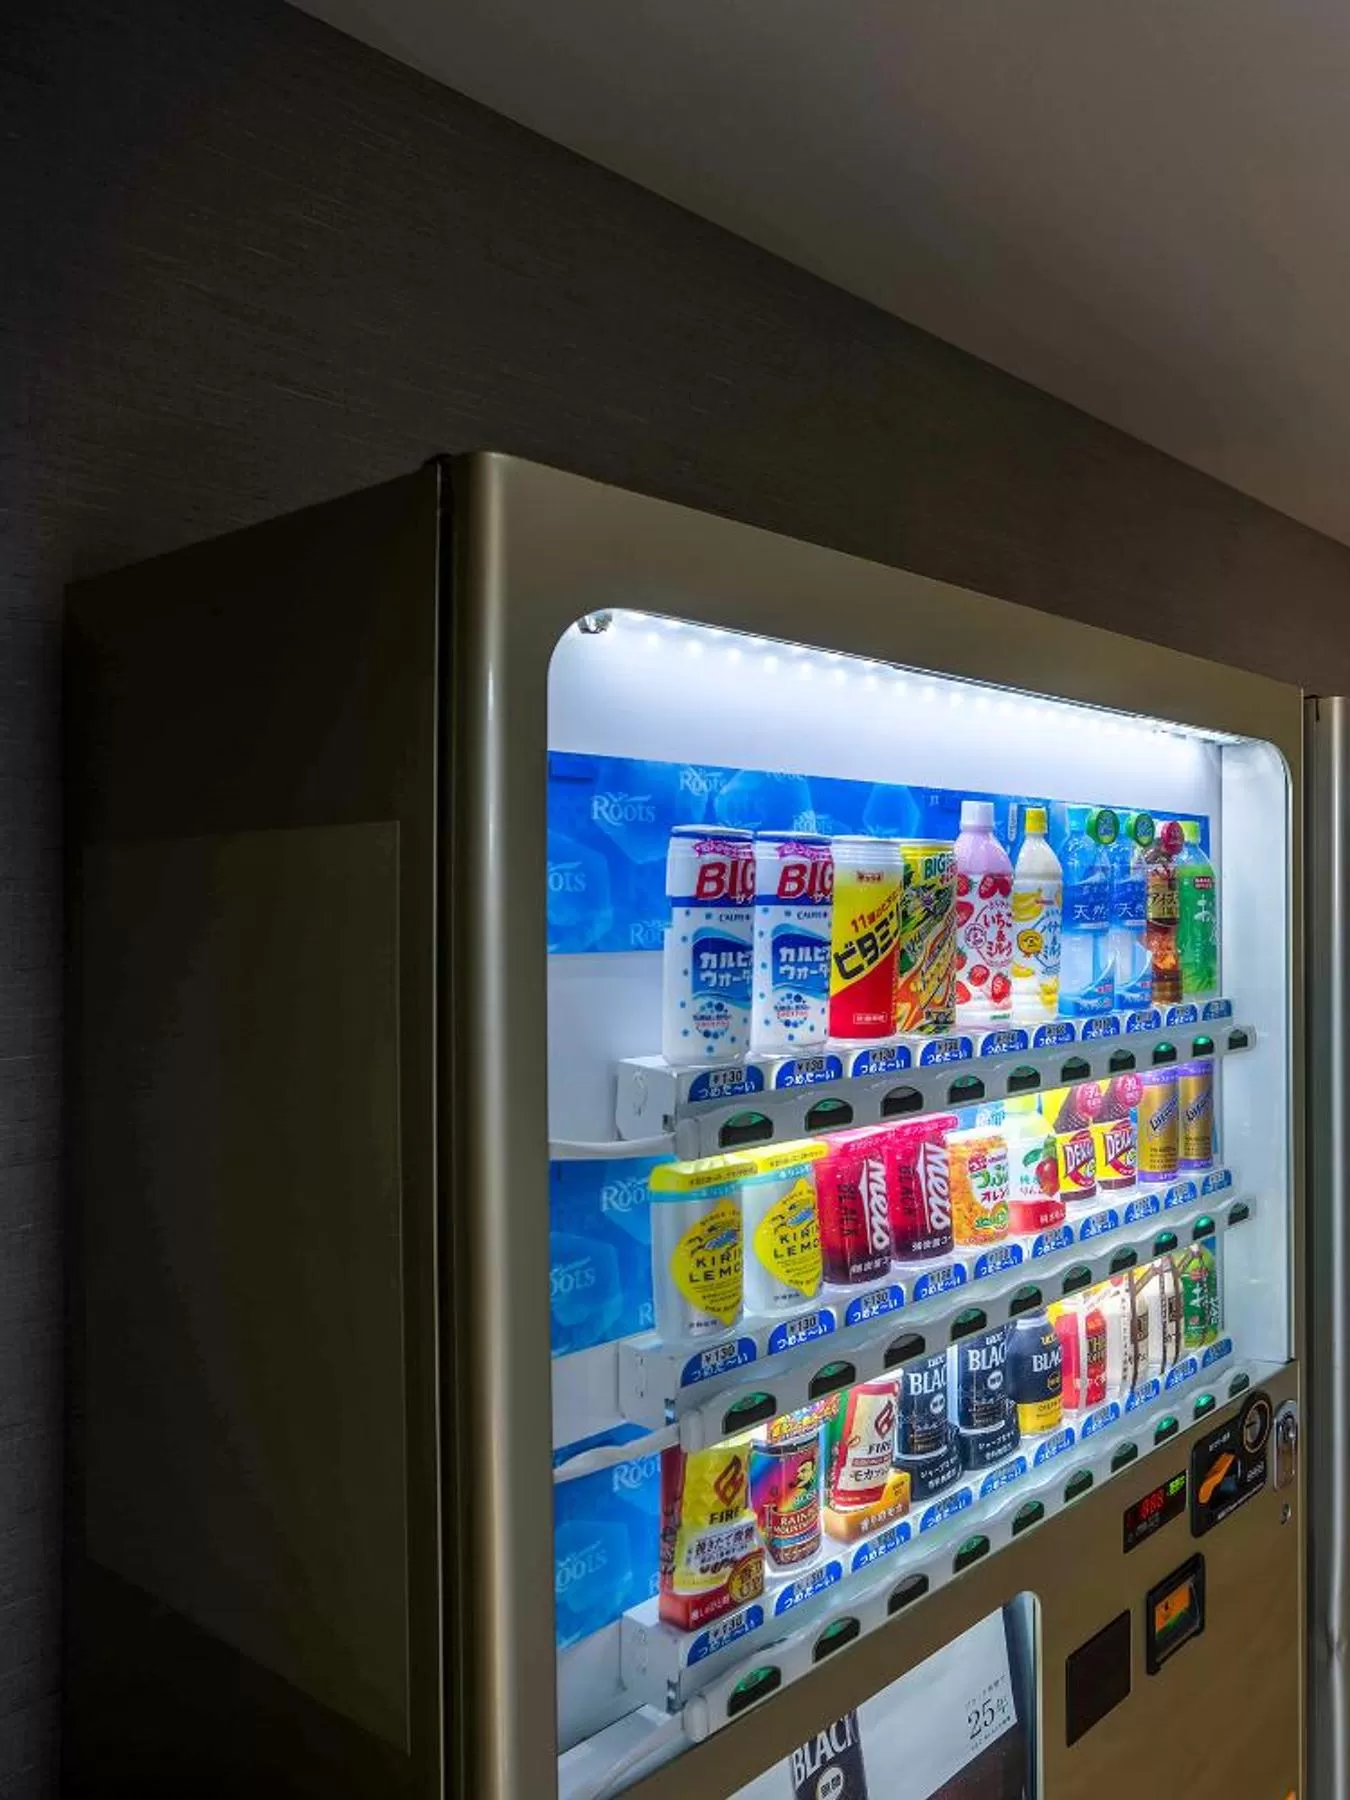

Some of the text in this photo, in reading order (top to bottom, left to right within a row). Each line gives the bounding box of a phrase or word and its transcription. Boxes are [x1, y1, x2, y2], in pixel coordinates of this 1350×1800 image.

[591, 794, 656, 827] Roots
[700, 950, 753, 970] カルピ
[778, 945, 830, 964] カルピ
[779, 1225, 817, 1245] KIRI
[773, 1239, 821, 1259] LEMO
[695, 1250, 743, 1269] KIRI
[688, 1264, 743, 1284] LEMO
[968, 1341, 1007, 1372] BLAC
[908, 1364, 948, 1396] BLAC
